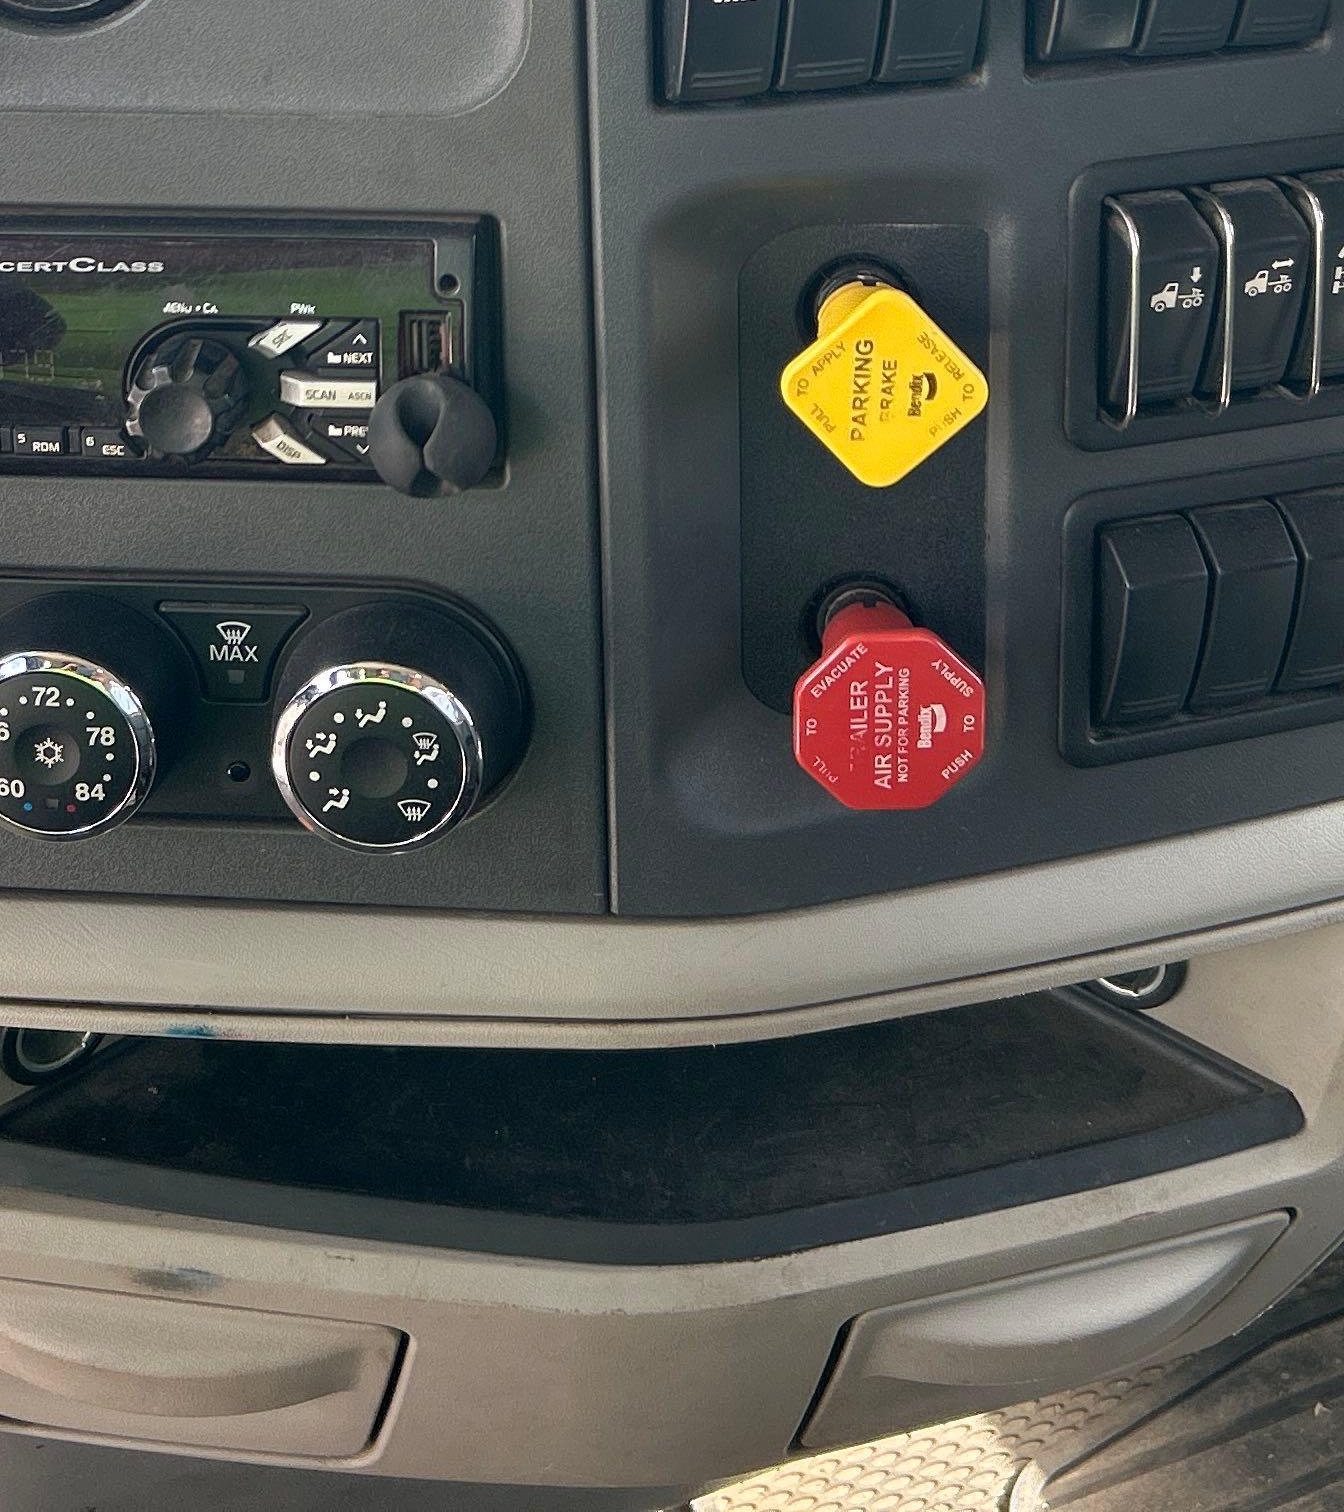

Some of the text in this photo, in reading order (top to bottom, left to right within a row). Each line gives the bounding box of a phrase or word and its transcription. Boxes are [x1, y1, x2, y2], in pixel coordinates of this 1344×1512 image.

[343, 352, 374, 364] NEXT
[917, 331, 965, 381] RELEASE
[305, 389, 373, 401] SCAN ASCN
[797, 341, 847, 433] PULL TO APPLY
[850, 339, 874, 441] PARKING
[907, 373, 924, 417] Bendix
[962, 383, 975, 401] TO
[343, 424, 369, 437] PRE
[17, 433, 60, 452] 5 RDM
[85, 436, 125, 456] 6 ESC
[276, 439, 301, 460] DISP
[209, 644, 259, 663] MAX
[31, 687, 61, 707] 72
[806, 642, 868, 783] PULL TO EVACUATE
[930, 658, 975, 780] PUSH TO SUPPLY
[850, 680, 869, 771] AILER
[874, 661, 893, 789] AIR SUPPLY
[897, 667, 910, 783] NOT FOR PARKING
[917, 704, 933, 749] Bendix
[86, 726, 115, 746] 78
[74, 782, 106, 801] 84
